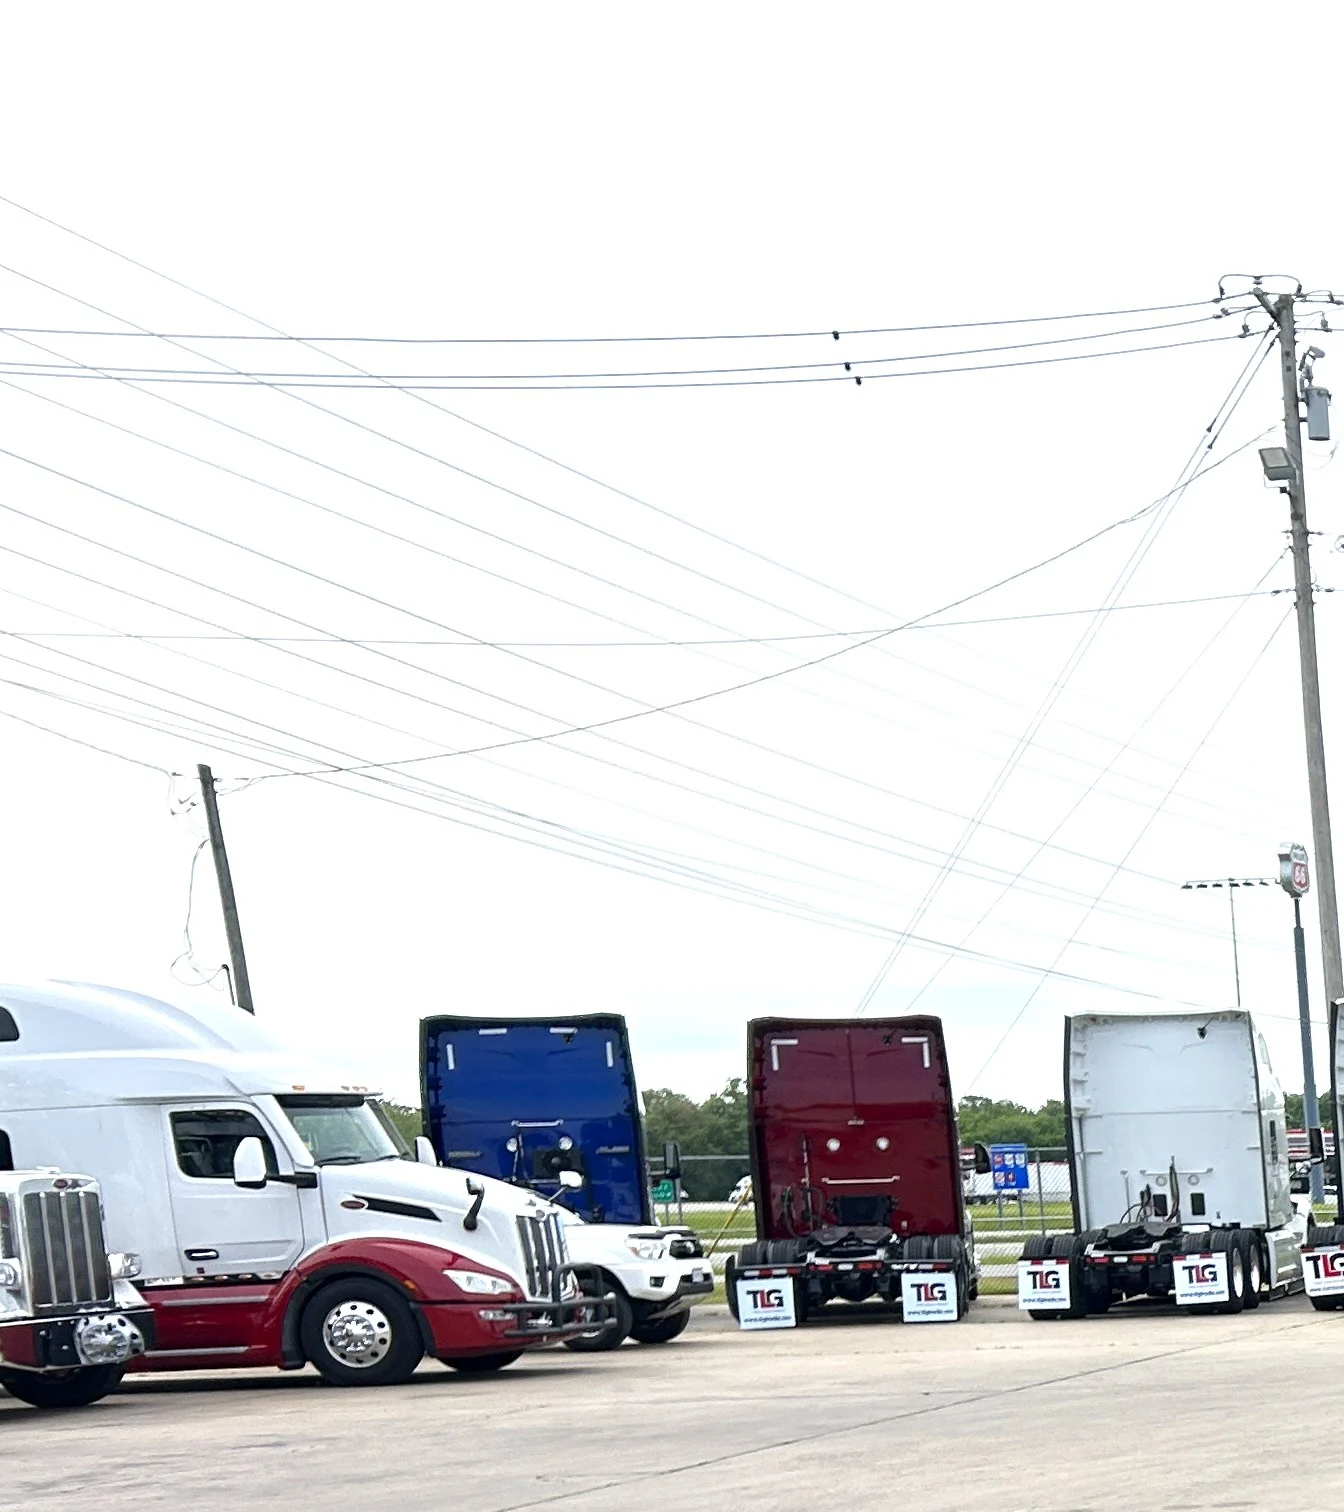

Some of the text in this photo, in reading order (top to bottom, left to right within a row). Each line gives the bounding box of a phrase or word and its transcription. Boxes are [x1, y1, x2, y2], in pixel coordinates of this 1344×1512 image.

[1026, 1270, 1061, 1290] TLG
[1182, 1264, 1218, 1285] TLG
[746, 1289, 784, 1309] TLG
[910, 1283, 947, 1302] TLG
